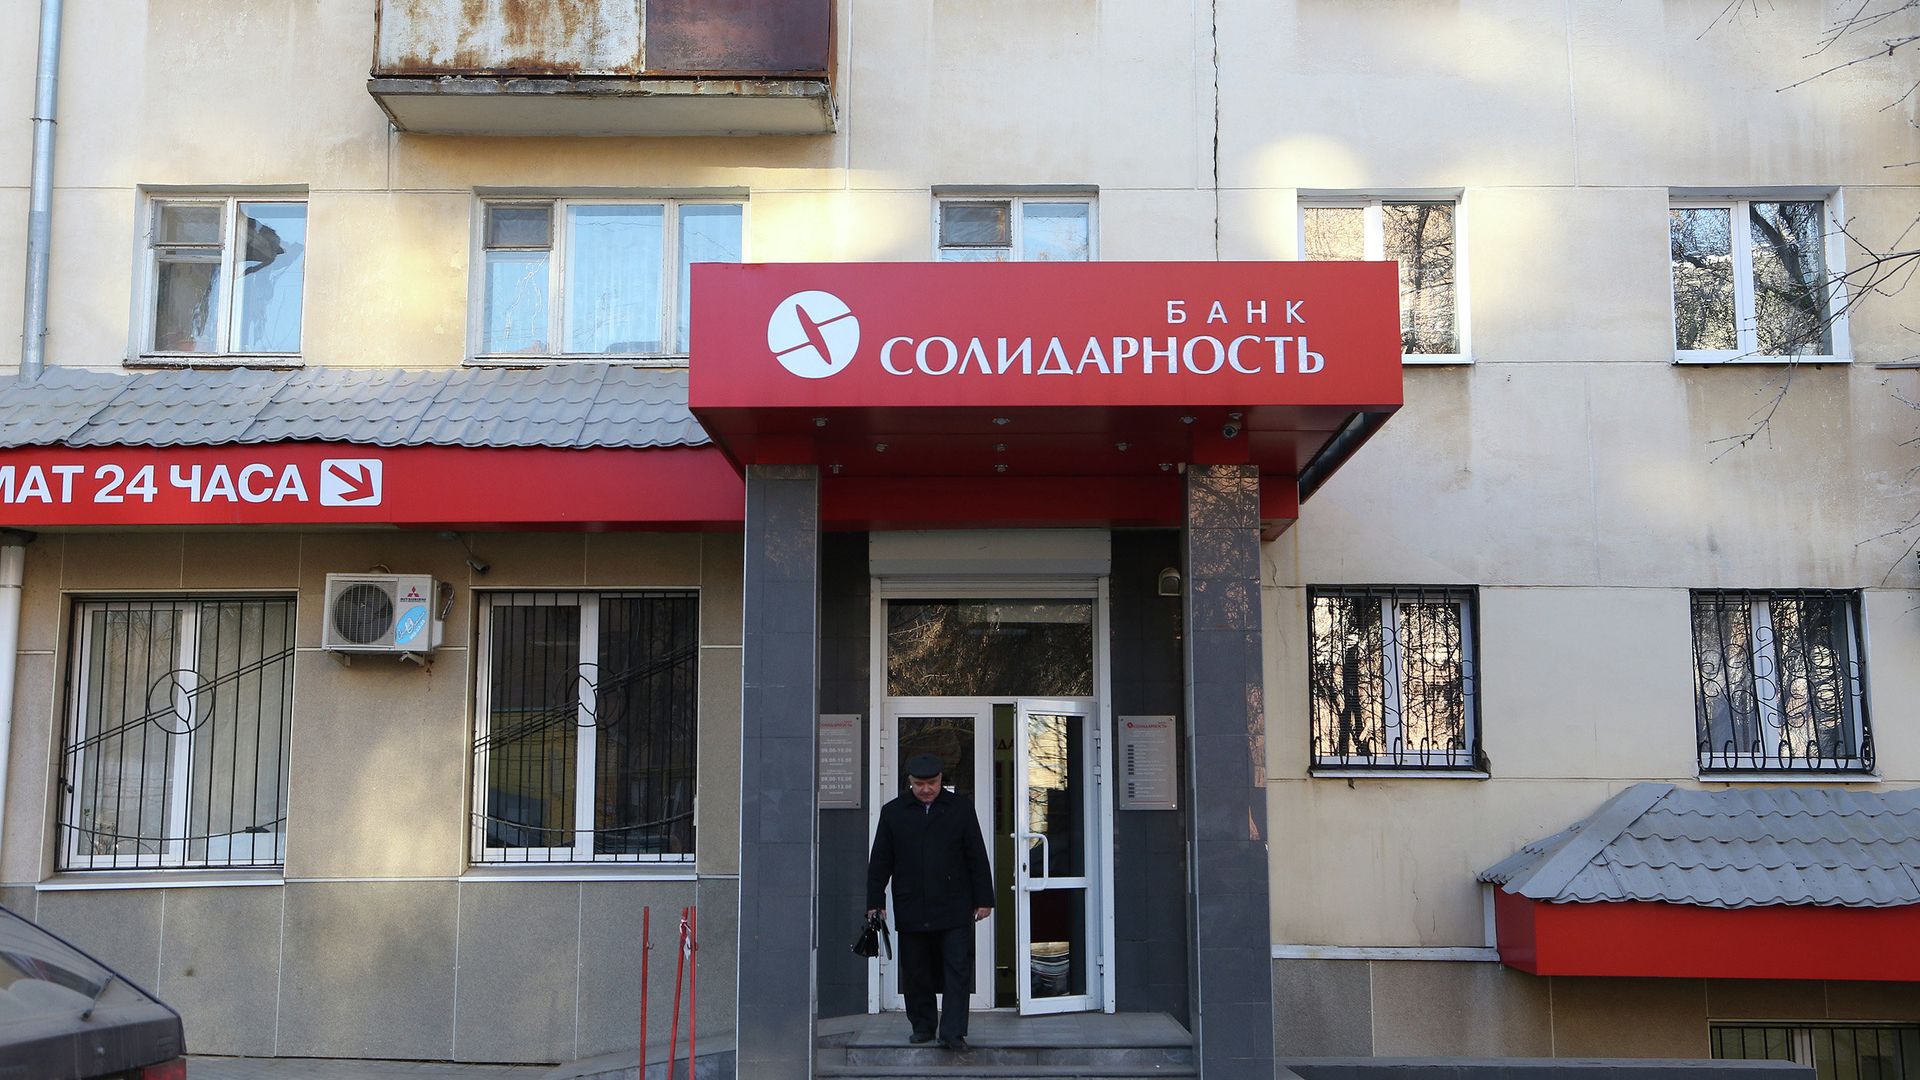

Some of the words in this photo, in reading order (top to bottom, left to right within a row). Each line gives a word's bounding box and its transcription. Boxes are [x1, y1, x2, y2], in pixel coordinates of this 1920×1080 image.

[1166, 300, 1307, 324] БАНК
[880, 335, 1325, 376] СОЛИДАРНОСТЬ
[94, 464, 158, 504] 24
[169, 463, 309, 503] ЧАСА
